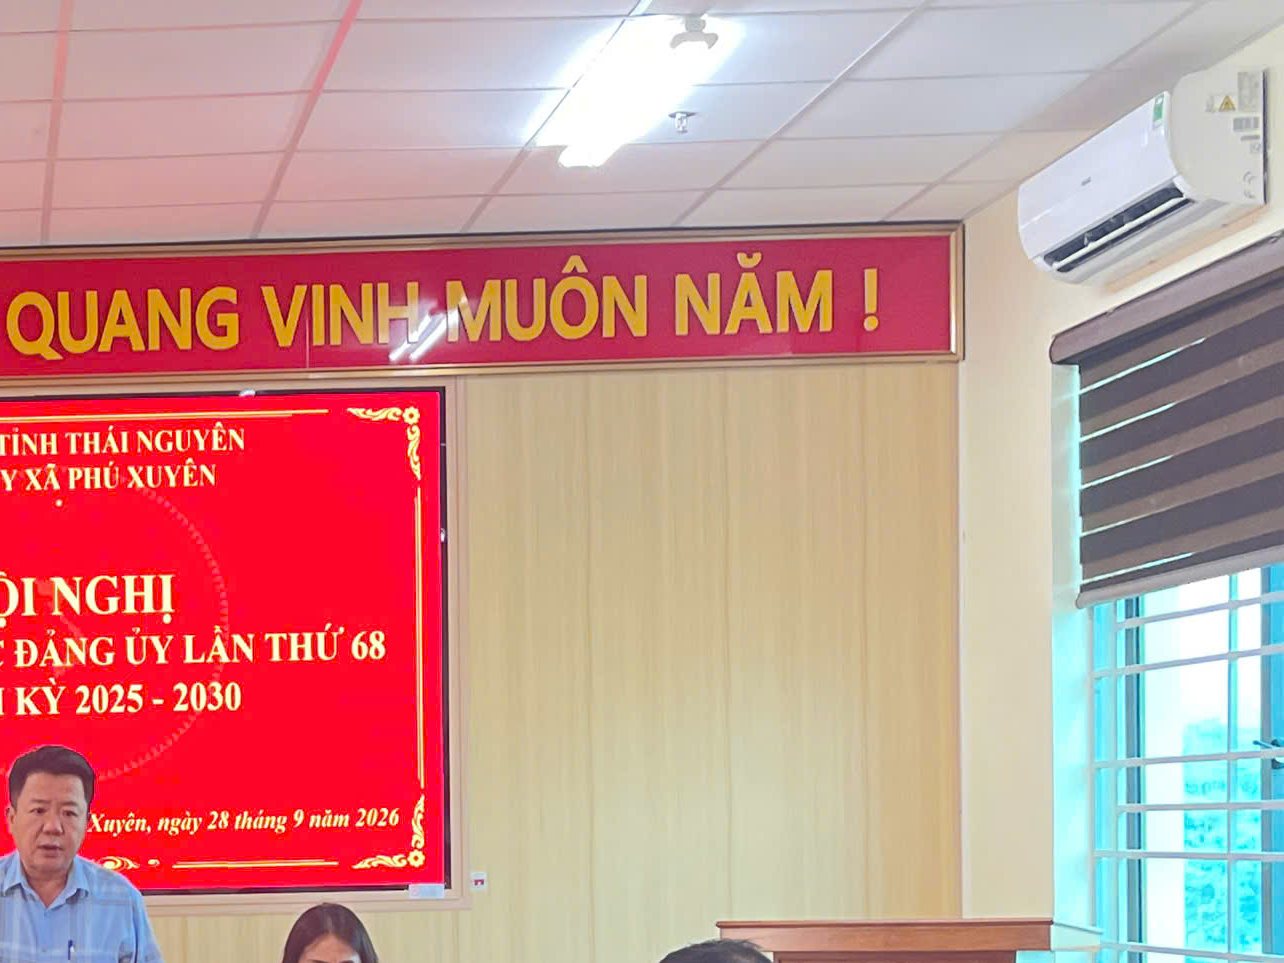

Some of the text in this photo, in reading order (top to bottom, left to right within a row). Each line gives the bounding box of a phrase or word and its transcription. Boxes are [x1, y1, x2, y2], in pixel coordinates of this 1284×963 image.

[6, 286, 239, 362] QUANG
[261, 282, 420, 350] VINH
[444, 254, 649, 346] MUÔN
[675, 251, 834, 336] NĂM
[861, 267, 880, 330] !
[65, 425, 128, 454] THÁI
[136, 421, 245, 452] NGUYÊN
[25, 463, 61, 491] XÃ
[68, 460, 120, 490] PHÚ
[127, 458, 216, 488] XUYÊN
[51, 573, 175, 625] NGHỊ
[14, 629, 116, 668] ĐẢNG
[125, 626, 174, 665] ỦY
[183, 624, 255, 664] LẦN
[264, 622, 345, 662] THỨ
[351, 630, 386, 660] 68
[14, 677, 67, 716] KỲ
[75, 683, 144, 714] 2025
[173, 681, 242, 712] 2030
[88, 807, 400, 837] Xuyên, ngày 28 tháng 9 năm 2026
